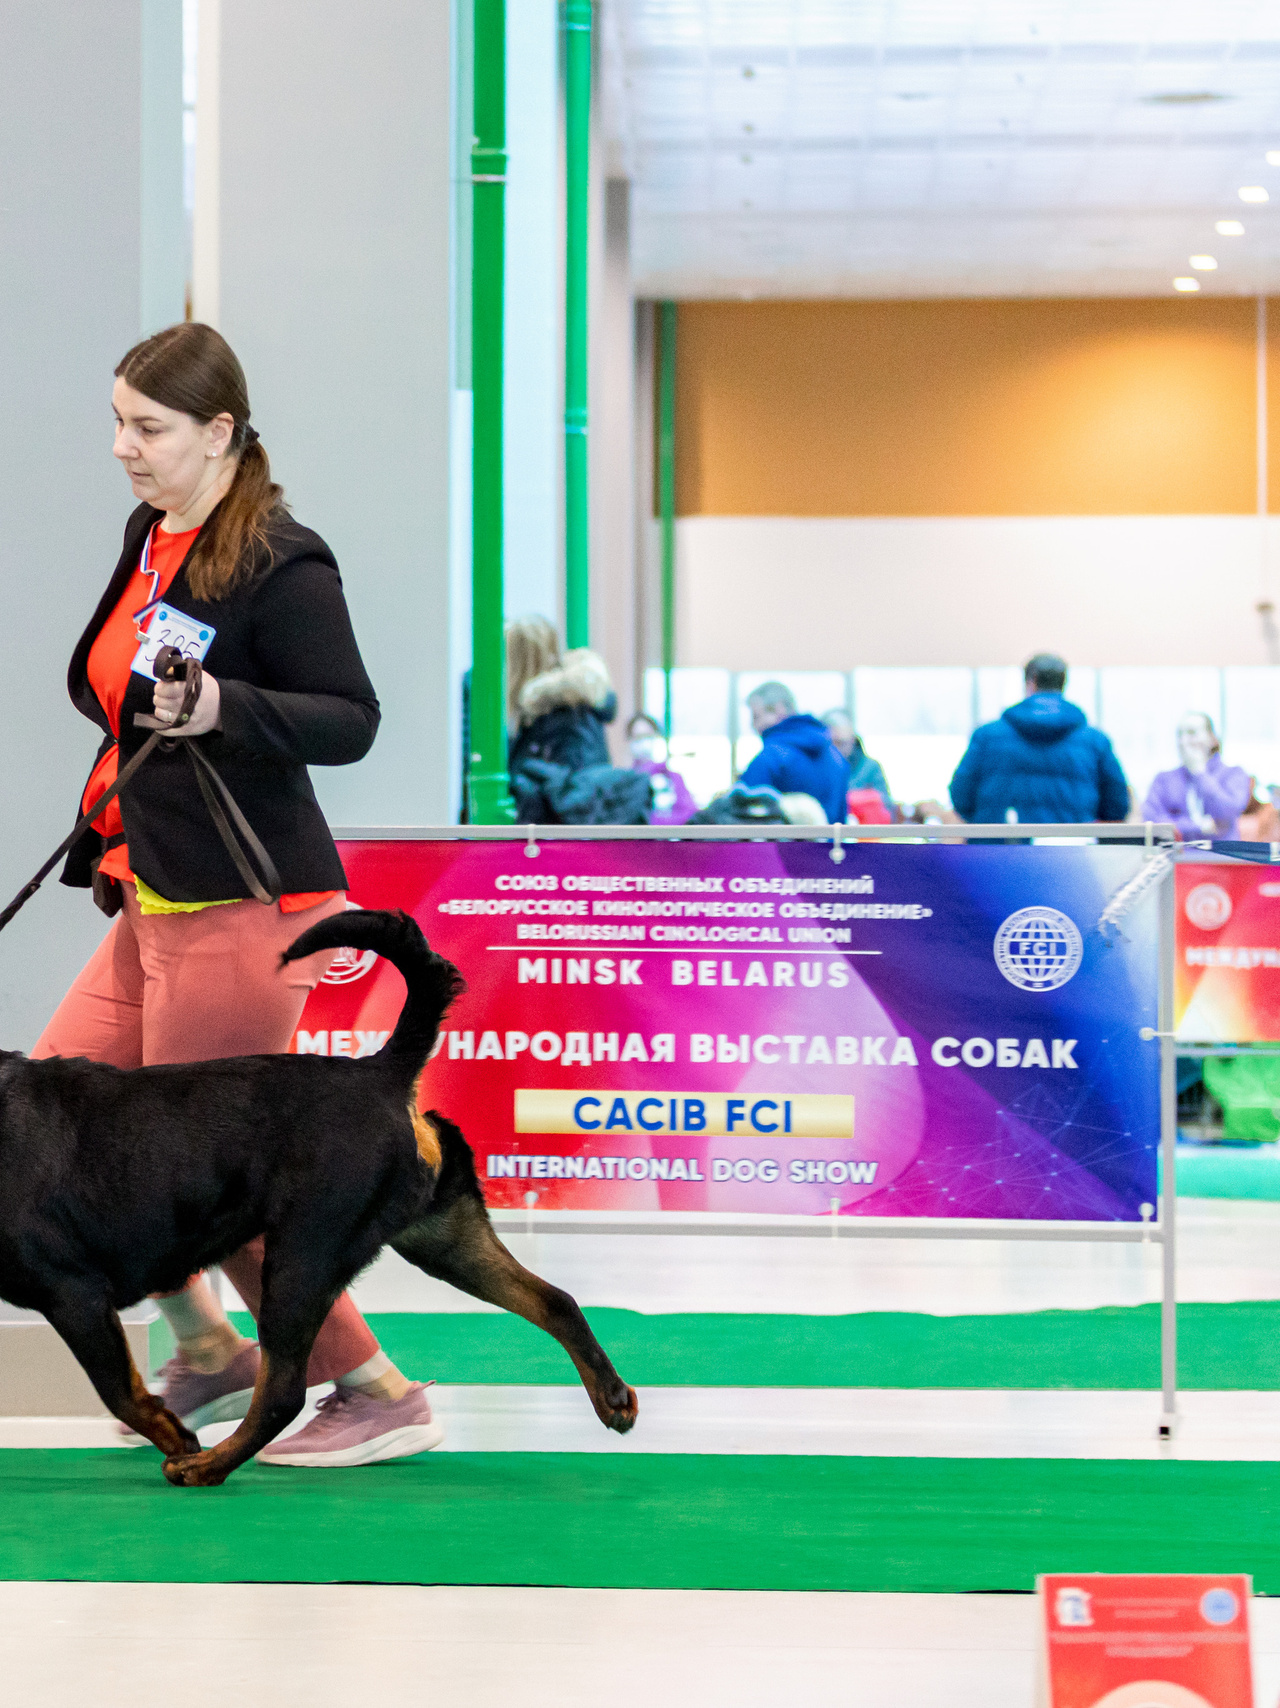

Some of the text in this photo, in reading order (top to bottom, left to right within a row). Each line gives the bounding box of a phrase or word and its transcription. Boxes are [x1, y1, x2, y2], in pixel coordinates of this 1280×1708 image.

[495, 875, 874, 895] СОЮЗ ОБЩЕСТВЕННЫХ ОБЪЕДИНЕНИЙ
[592, 901, 775, 917] КИНОЛОГИЧЕСКОЕ
[517, 924, 852, 943] BELORUSSIAN CINOLOGICAL UNION
[1018, 943, 1057, 956] FCI
[518, 958, 850, 988] MINSK BELARUS
[690, 1034, 918, 1066] ВЫСТАВКА
[931, 1037, 1079, 1069] СОБАК
[574, 1096, 792, 1134] CACIB FCI
[486, 1155, 879, 1186] INTERNATIONAL DOG SHOW
